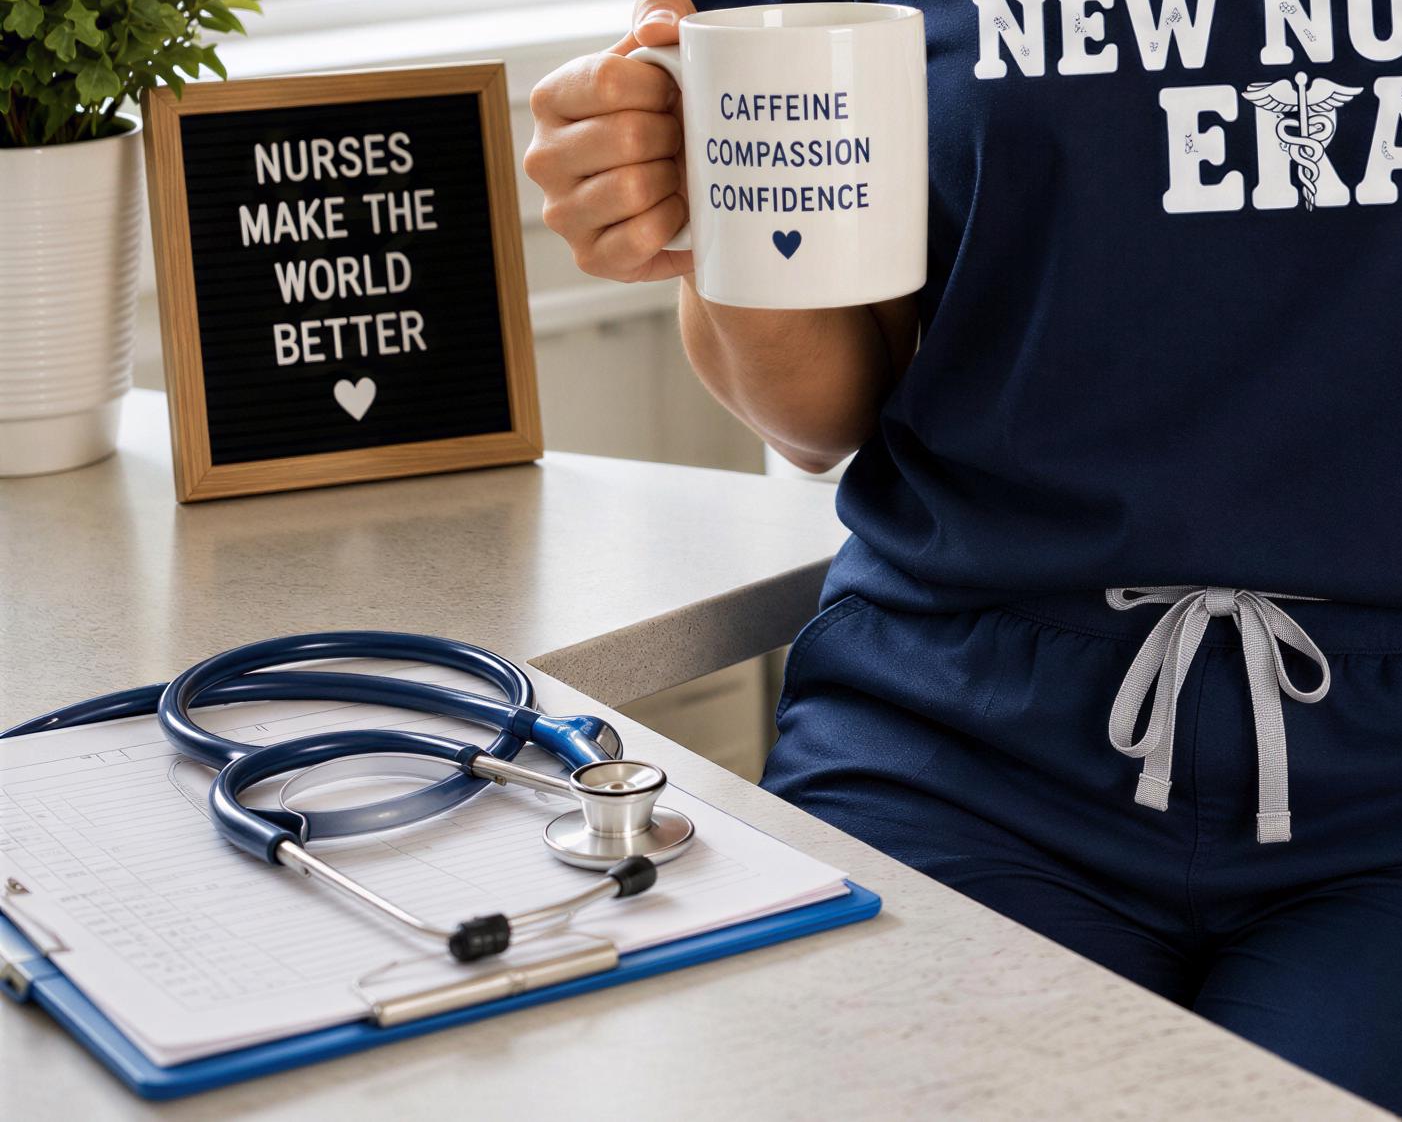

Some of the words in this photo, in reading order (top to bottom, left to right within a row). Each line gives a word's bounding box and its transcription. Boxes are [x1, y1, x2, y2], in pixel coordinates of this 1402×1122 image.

[720, 92, 849, 122] CAFFEINE
[254, 131, 414, 185] NURSES
[706, 137, 870, 168] COMPASSION
[238, 196, 349, 247] MAKE
[362, 188, 438, 235] THE
[710, 182, 869, 213] CONFIDENCE
[274, 251, 412, 304] WORLD
[273, 310, 427, 366] BETTER
